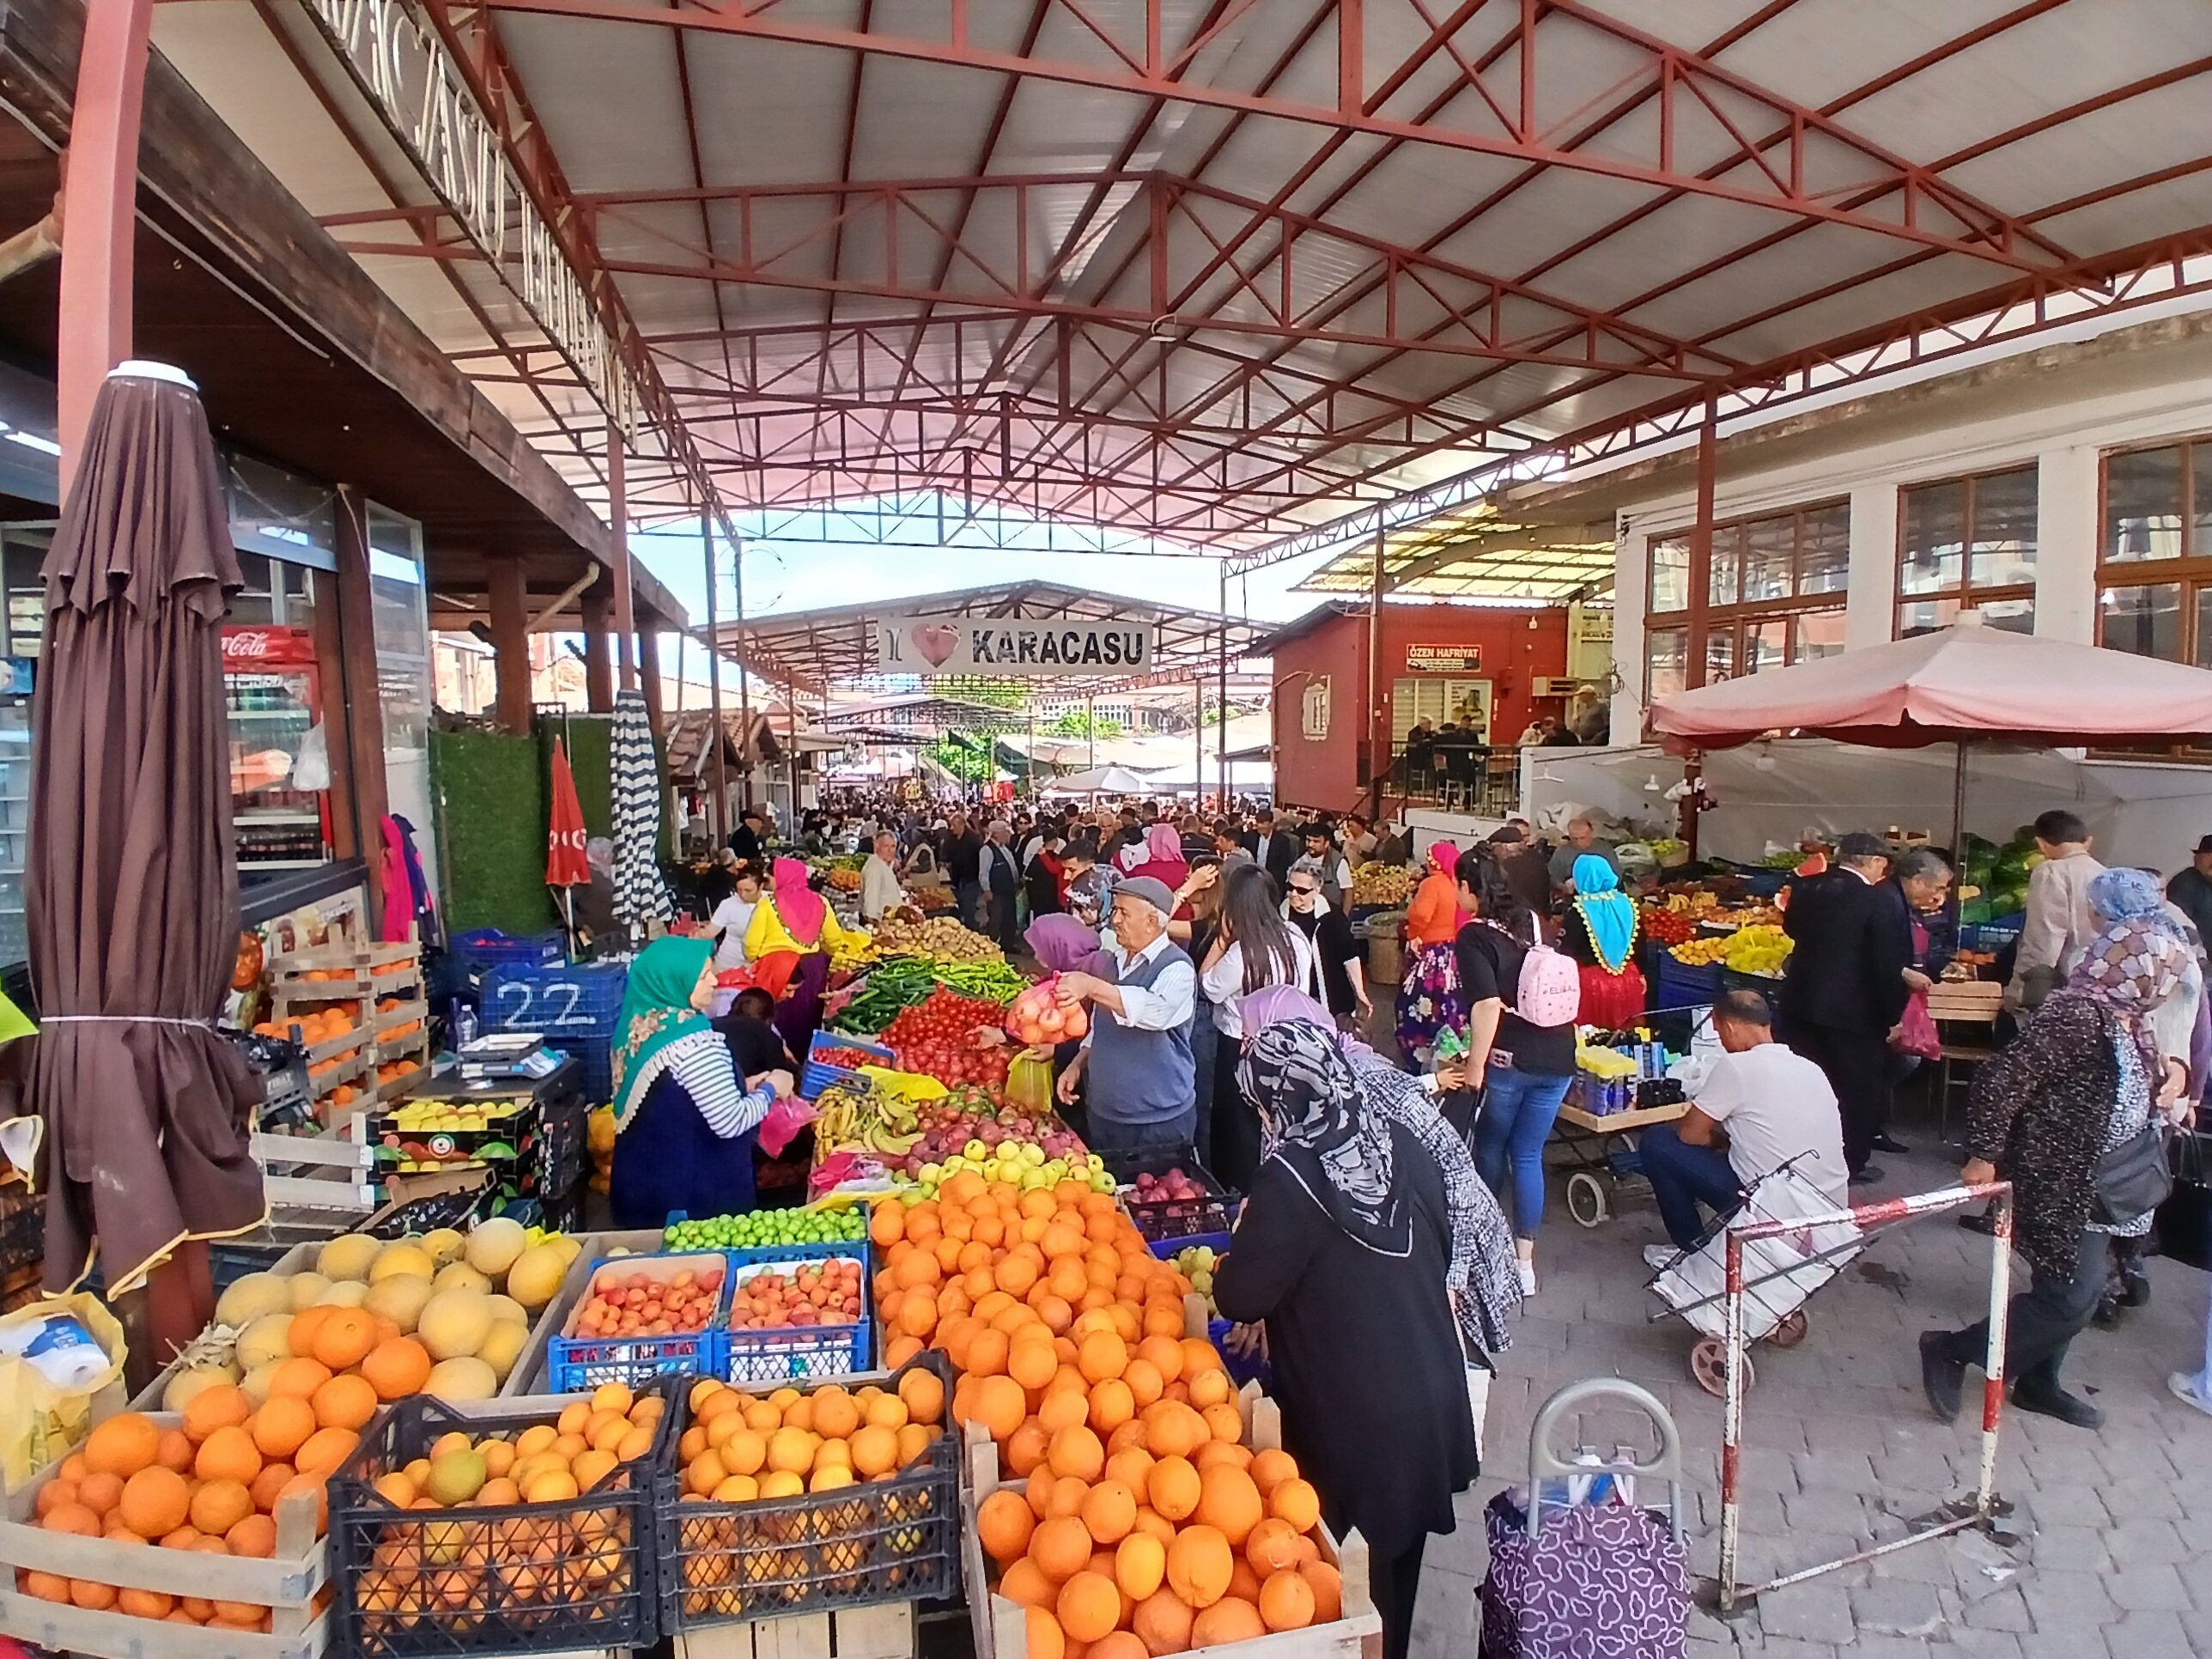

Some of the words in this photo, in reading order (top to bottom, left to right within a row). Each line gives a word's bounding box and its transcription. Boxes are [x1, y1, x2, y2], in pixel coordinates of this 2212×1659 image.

[886, 627, 902, 662] I
[972, 629, 1143, 665] KARACASU
[1409, 645, 1434, 658] ÖZEN
[497, 981, 596, 1029] 22
